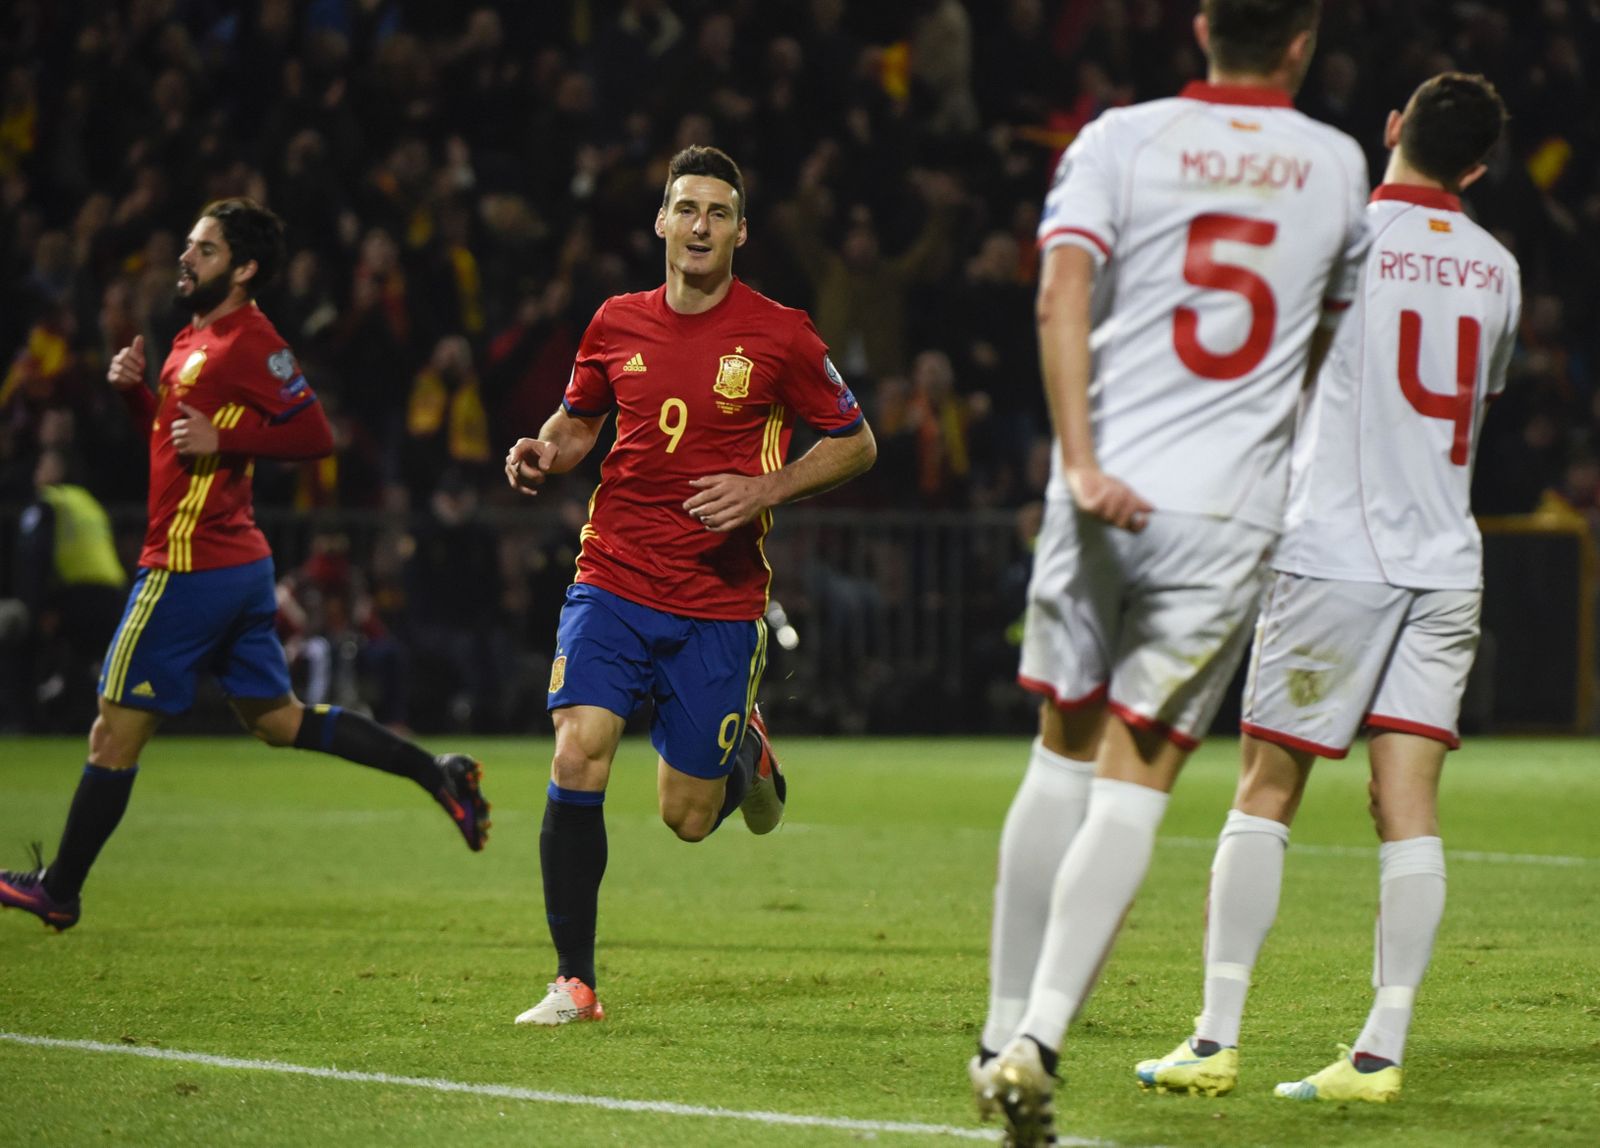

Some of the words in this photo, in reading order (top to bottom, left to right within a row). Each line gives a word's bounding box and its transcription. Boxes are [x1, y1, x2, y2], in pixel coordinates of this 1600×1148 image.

[1181, 150, 1311, 191] MOJSOV
[1173, 213, 1277, 380] 5
[1380, 251, 1504, 294] RISTEVSKI
[1398, 309, 1480, 465] 4
[659, 398, 688, 454] 9
[718, 713, 740, 765] 9
